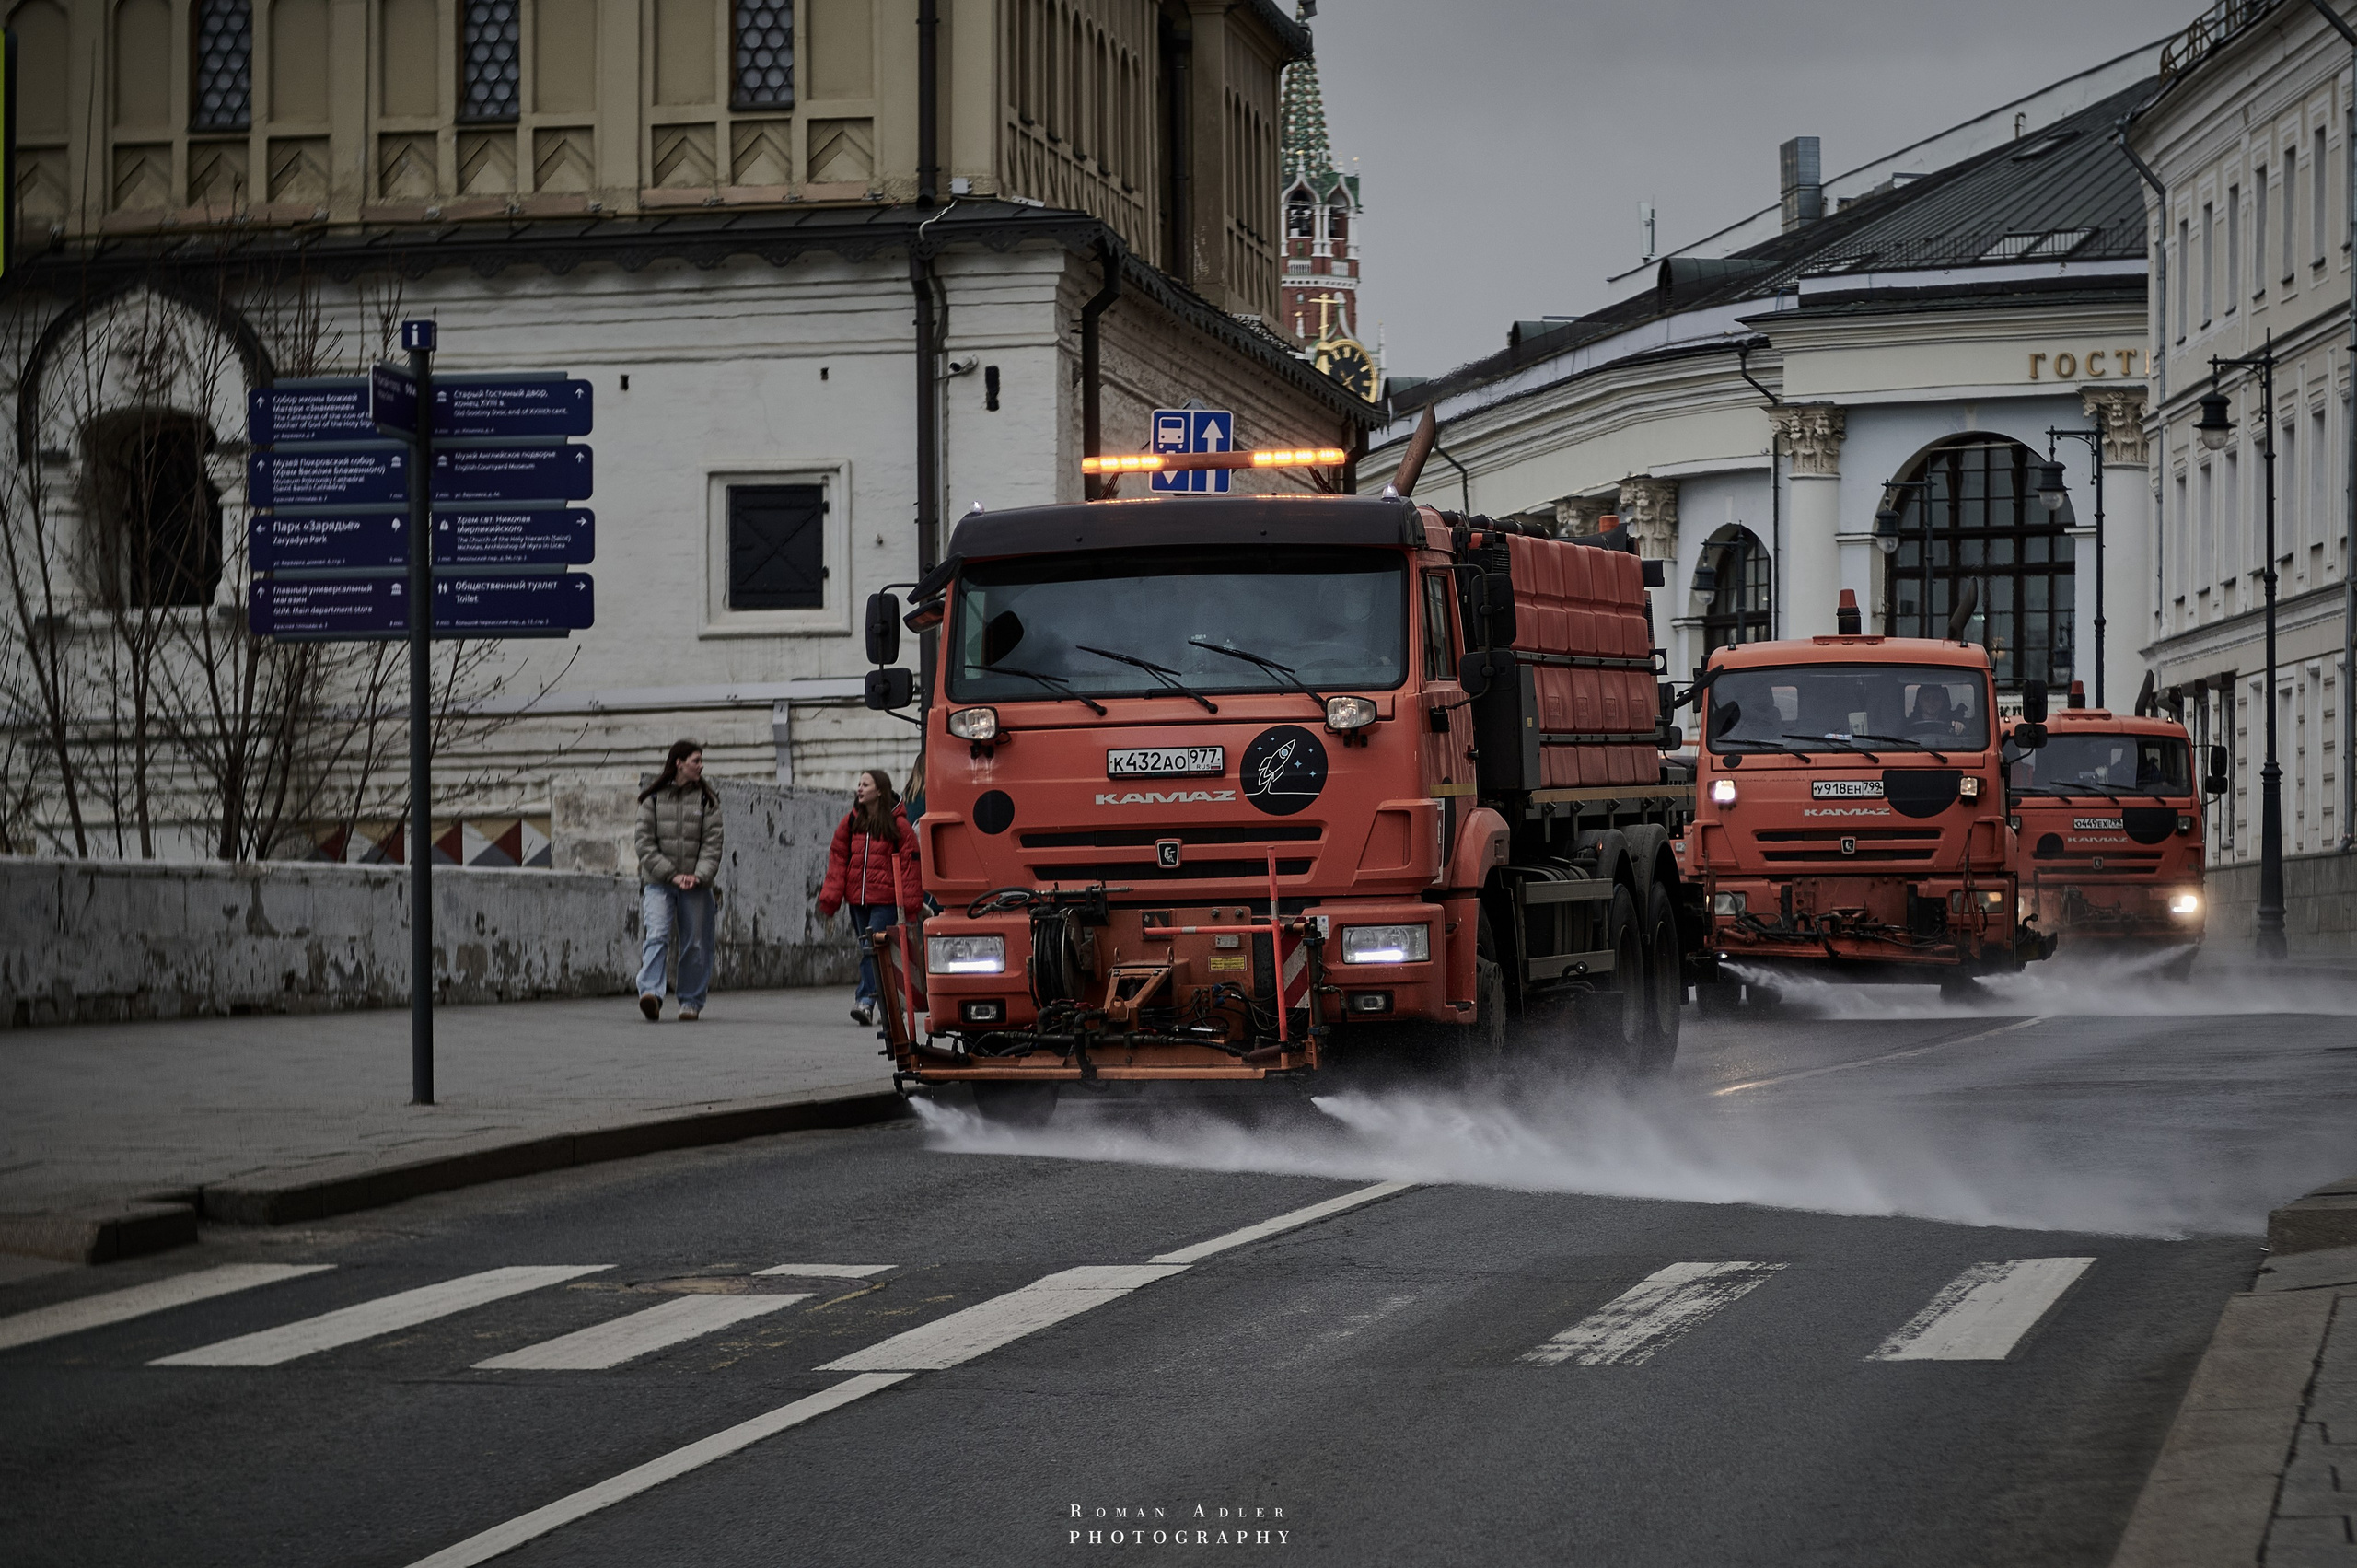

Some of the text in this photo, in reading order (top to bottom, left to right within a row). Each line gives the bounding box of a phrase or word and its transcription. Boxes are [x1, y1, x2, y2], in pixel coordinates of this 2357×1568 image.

[2028, 348, 2149, 380] ГОСТ
[273, 394, 297, 405] Собор
[453, 388, 549, 400] Старый Гостиный двор,
[273, 405, 304, 414] Матери
[273, 455, 376, 469] Музей Покровский собор
[454, 450, 557, 462] Музей Английское подворье
[299, 467, 332, 476] Василия
[454, 462, 477, 472] English
[273, 518, 361, 535] Парк «Зарядье»
[457, 515, 531, 526] Храм свт. Николая
[457, 524, 523, 535] Мирликийского
[273, 534, 328, 548] Zaryadye Park
[273, 582, 373, 598] Главный универсальный
[455, 579, 557, 593] Общественный туалет
[273, 597, 308, 606] магазин
[456, 594, 479, 604] Toilet
[292, 606, 309, 614] Main
[310, 605, 353, 617] department
[354, 605, 373, 614] store
[1114, 749, 1218, 772] К432АО 977
[1817, 782, 1881, 795] У918ЕН 799
[1096, 790, 1236, 806] KAMAZ
[1804, 807, 1890, 817] KAMAZ
